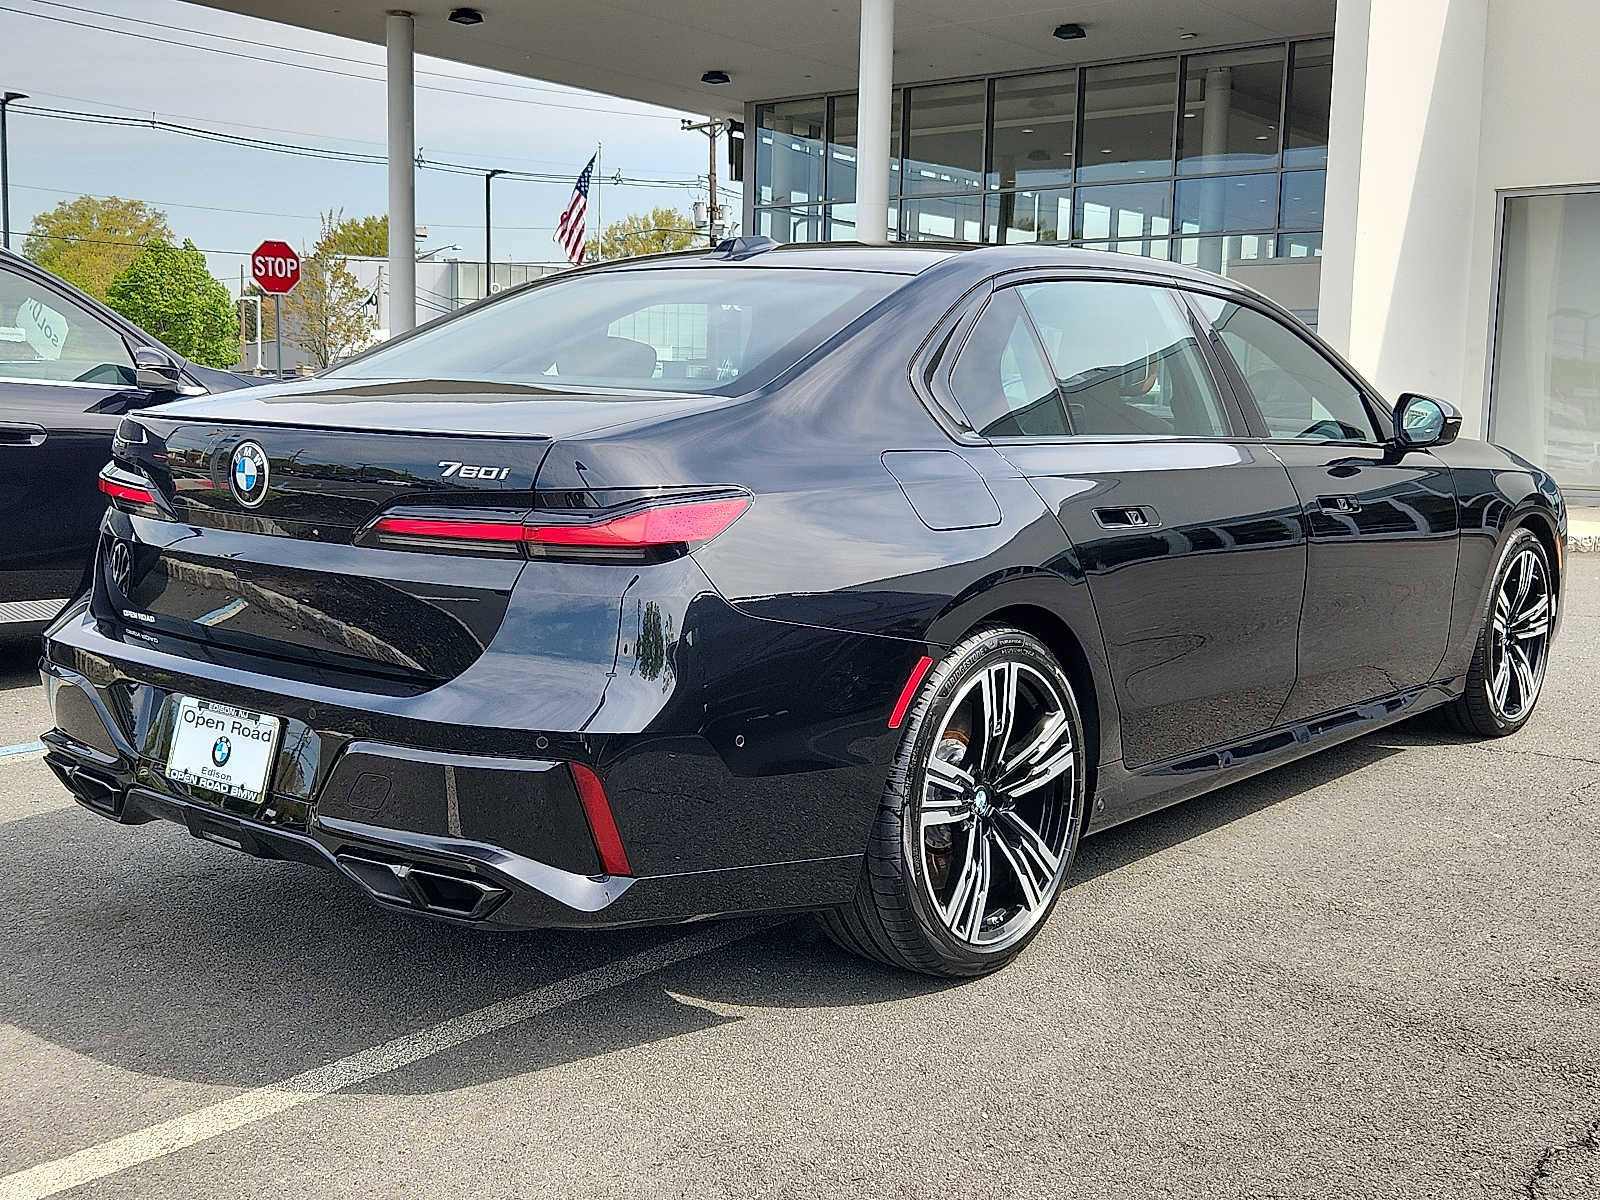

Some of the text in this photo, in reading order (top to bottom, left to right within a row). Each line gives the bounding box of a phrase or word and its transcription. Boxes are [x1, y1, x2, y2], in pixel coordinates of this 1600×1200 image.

[255, 256, 297, 277] STOP
[234, 446, 263, 467] BMW
[438, 461, 511, 480] 760i
[184, 709, 272, 743] Open Road
[202, 766, 232, 782] Edison
[171, 769, 258, 801] OPEN ROAD BMW
